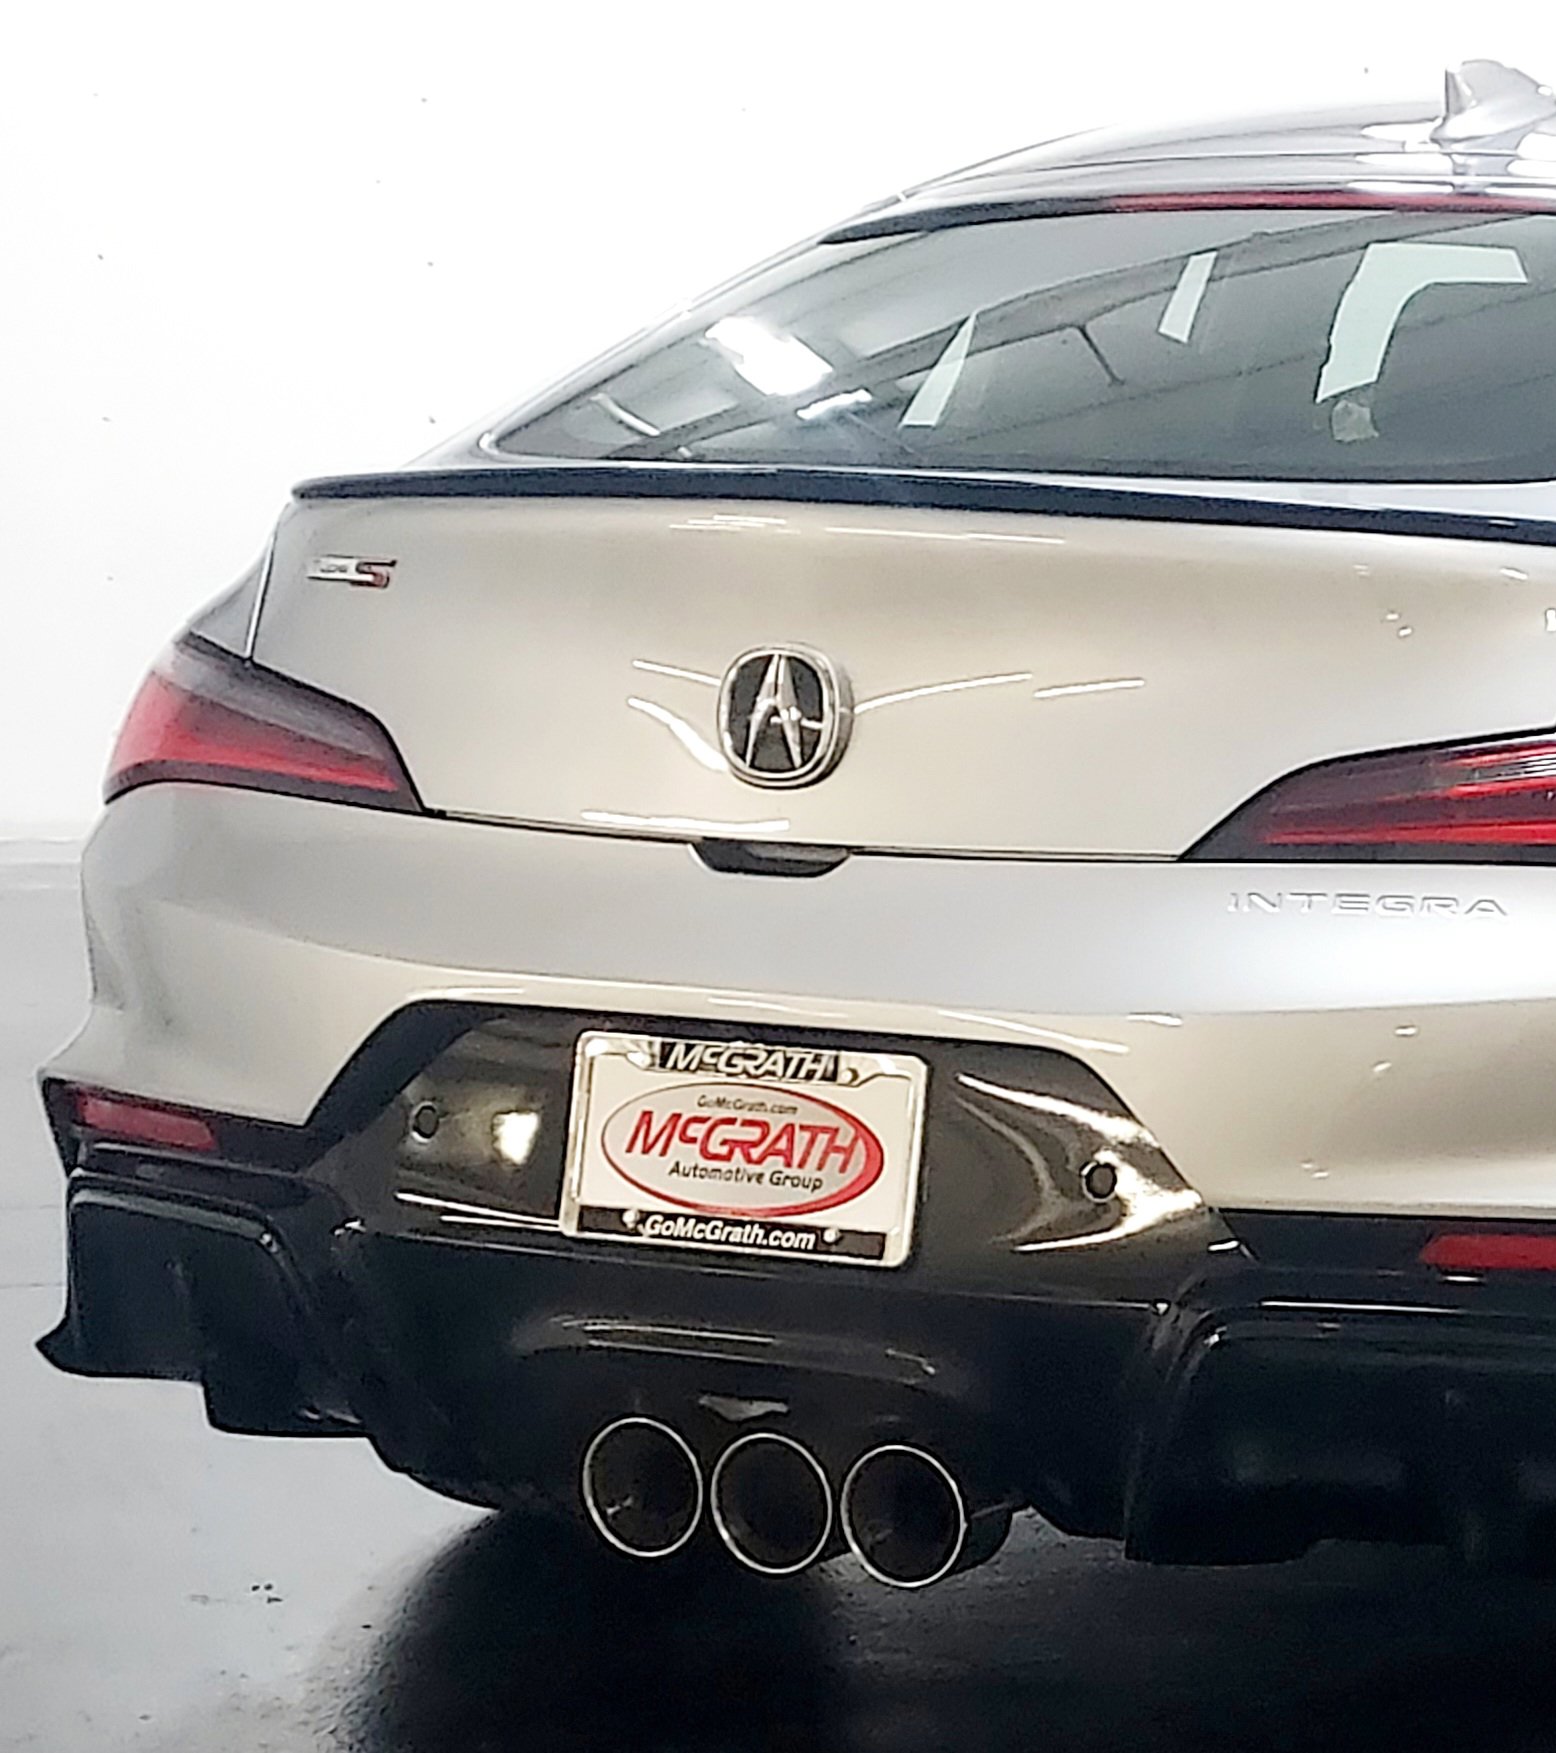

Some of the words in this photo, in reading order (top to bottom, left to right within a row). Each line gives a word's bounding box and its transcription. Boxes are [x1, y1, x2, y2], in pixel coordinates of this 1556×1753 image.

[1228, 892, 1508, 917] INTEGRA
[697, 1094, 799, 1115] GoMcGrath.com
[668, 1161, 764, 1186] Automotive
[768, 1170, 824, 1192] Group
[645, 1214, 817, 1250] GoMcGrath.com
